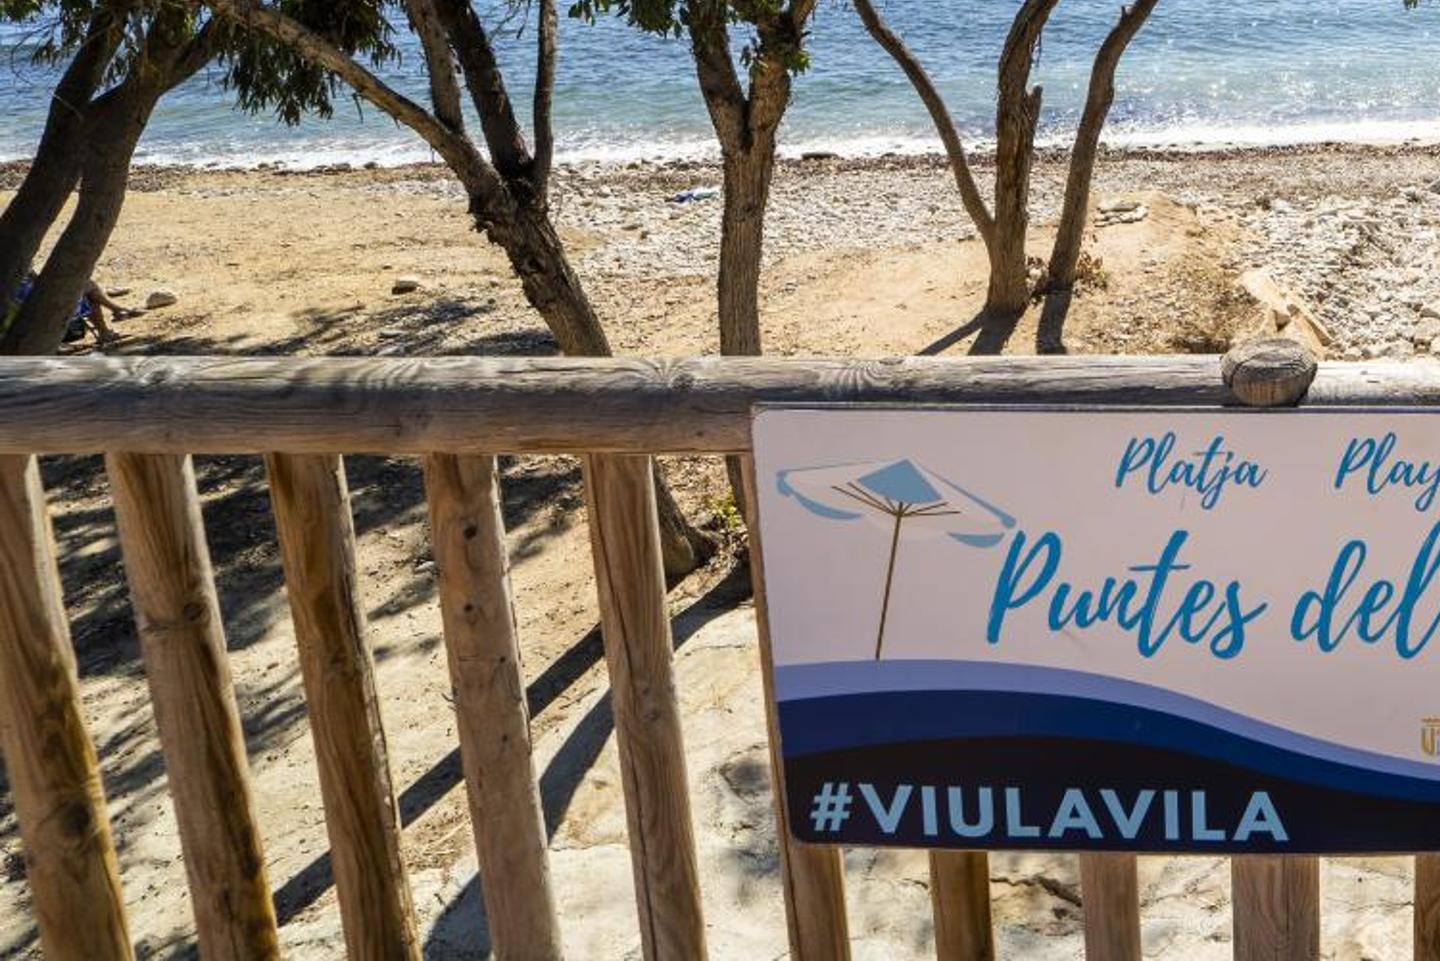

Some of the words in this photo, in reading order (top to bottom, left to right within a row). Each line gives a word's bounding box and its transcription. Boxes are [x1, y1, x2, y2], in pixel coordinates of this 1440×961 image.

[1115, 432, 1268, 510] Platja
[986, 529, 1268, 660] Puntes
[811, 782, 1289, 841] #VIULAVILA
